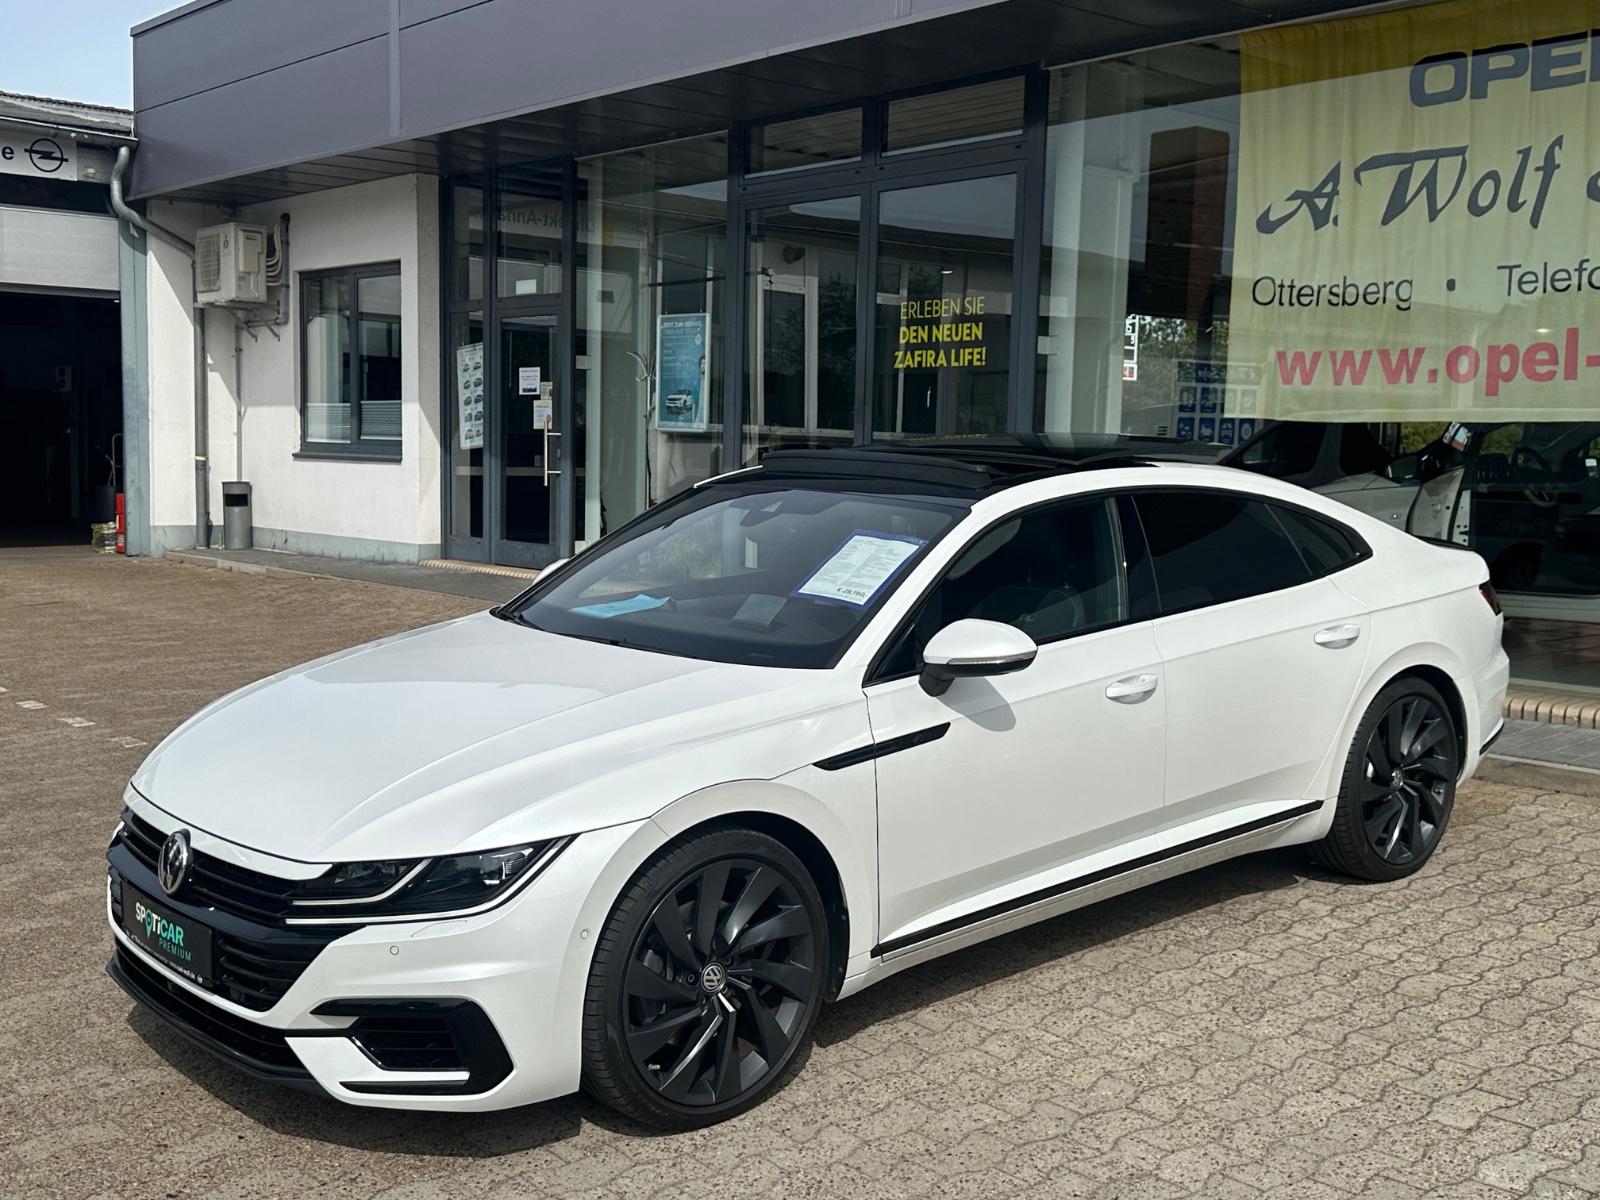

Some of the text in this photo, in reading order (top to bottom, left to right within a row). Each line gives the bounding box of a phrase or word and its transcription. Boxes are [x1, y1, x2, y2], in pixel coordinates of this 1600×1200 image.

[1409, 29, 1600, 107] OPE
[1354, 134, 1564, 229] Wolf
[900, 296, 985, 320] ERLEBEN SIE
[1252, 275, 1414, 311] Ottersberg
[900, 322, 983, 344] DEN NEUEN
[894, 346, 986, 369] ZAFIRA LIFE!
[1276, 327, 1600, 397] www.opel-
[159, 938, 192, 961] PREMIUM
